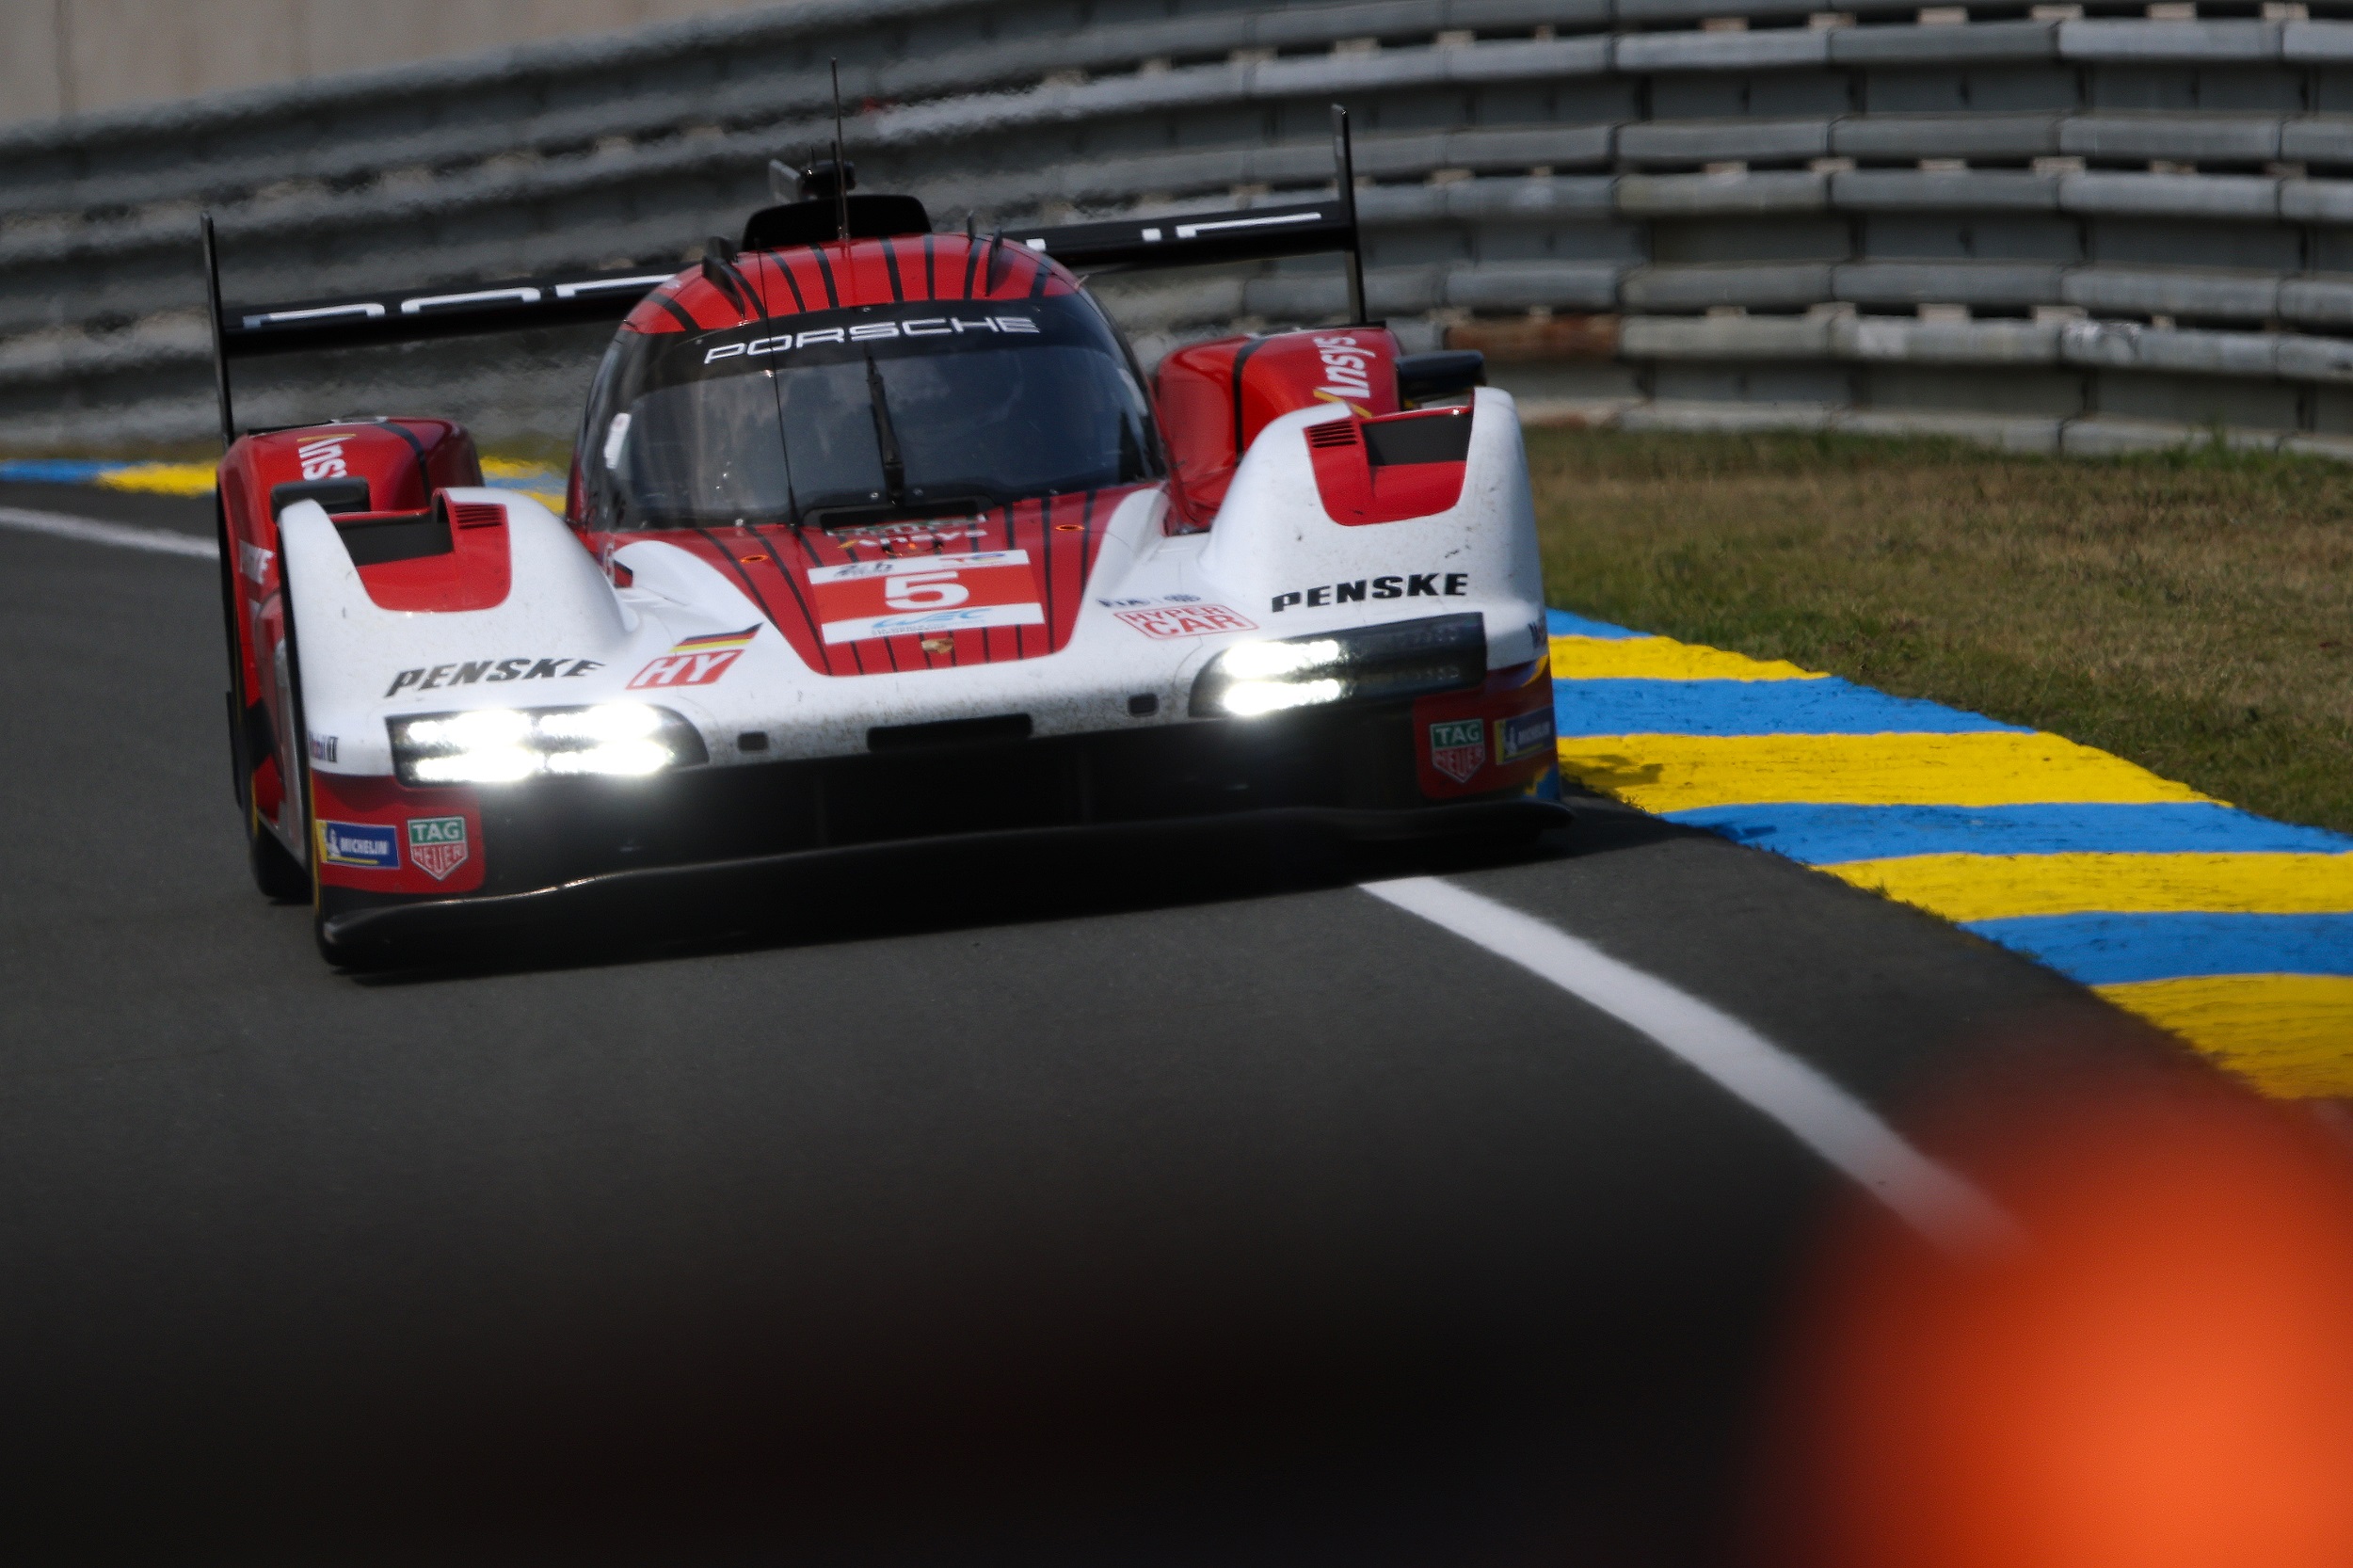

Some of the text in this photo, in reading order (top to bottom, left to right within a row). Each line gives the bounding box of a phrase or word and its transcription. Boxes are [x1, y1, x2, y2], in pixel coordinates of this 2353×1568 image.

[704, 316, 1040, 364] PORSCHE
[885, 570, 969, 609] 5
[1271, 572, 1469, 613] PENSKE
[1125, 607, 1226, 622] HYPER
[1144, 615, 1247, 636] CAR
[384, 658, 606, 697] PENSKE
[632, 651, 736, 686] HY
[1435, 724, 1481, 745] TAG
[412, 821, 459, 841] TAG
[340, 837, 389, 856] MICHELIN
[412, 844, 465, 873] HEUER
